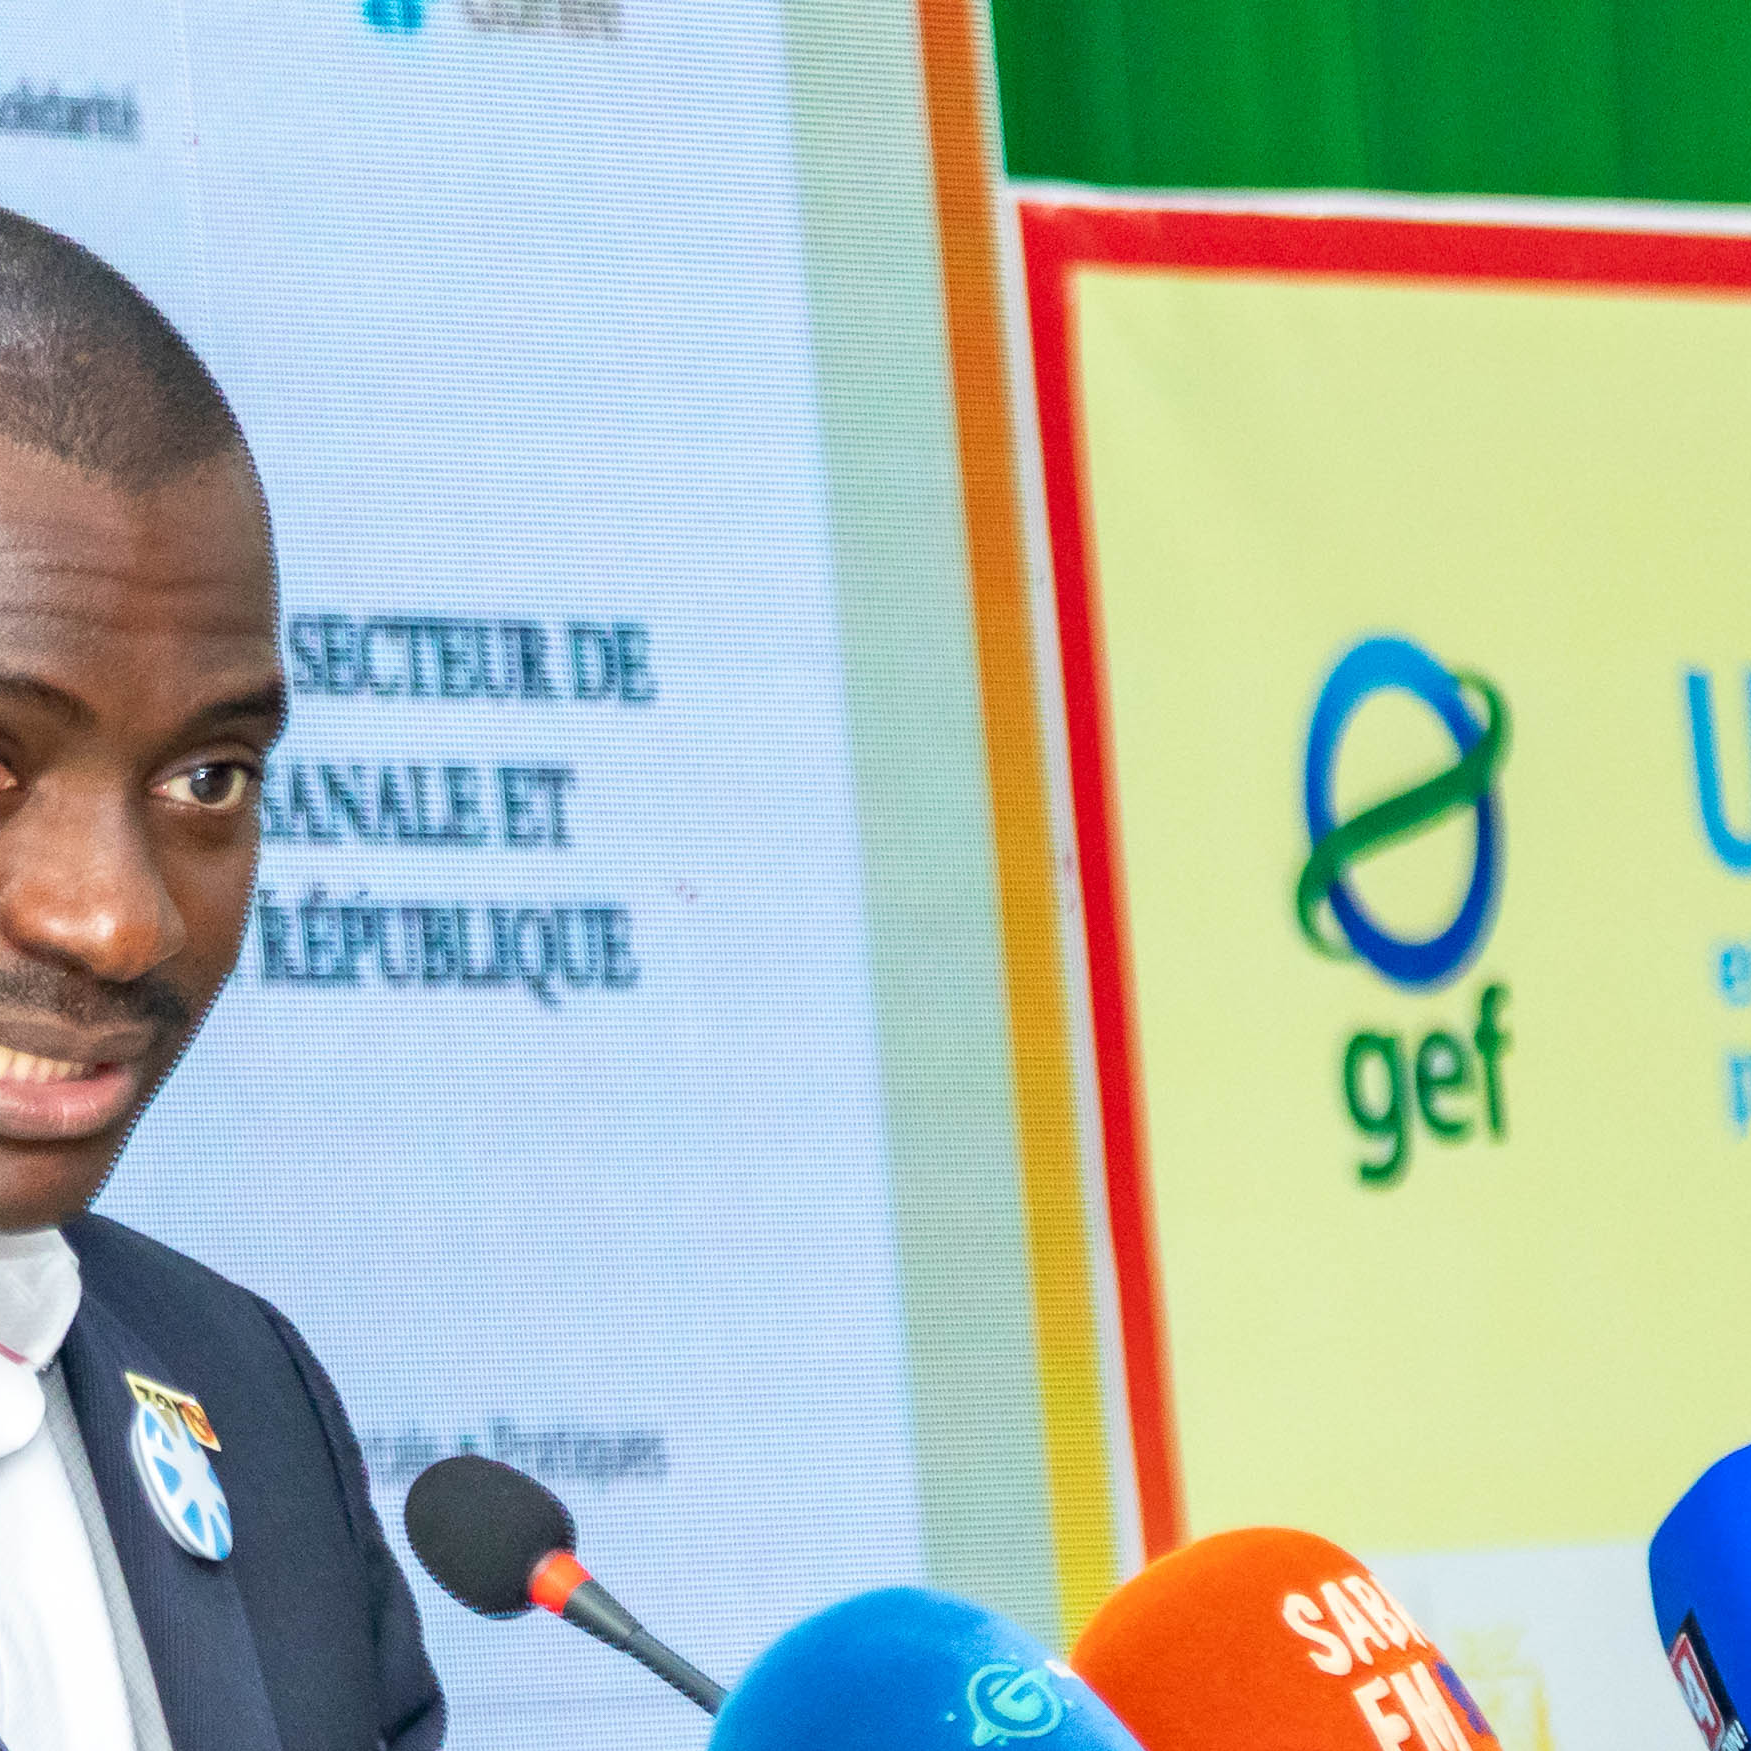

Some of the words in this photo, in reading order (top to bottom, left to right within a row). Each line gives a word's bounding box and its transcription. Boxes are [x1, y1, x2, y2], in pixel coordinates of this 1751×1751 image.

[288, 611, 557, 701] SECTEUR
[565, 620, 658, 704] DE
[496, 764, 577, 849] ET
[258, 882, 641, 1007] RÉPUBLIQUE
[1342, 983, 1511, 1190] gef
